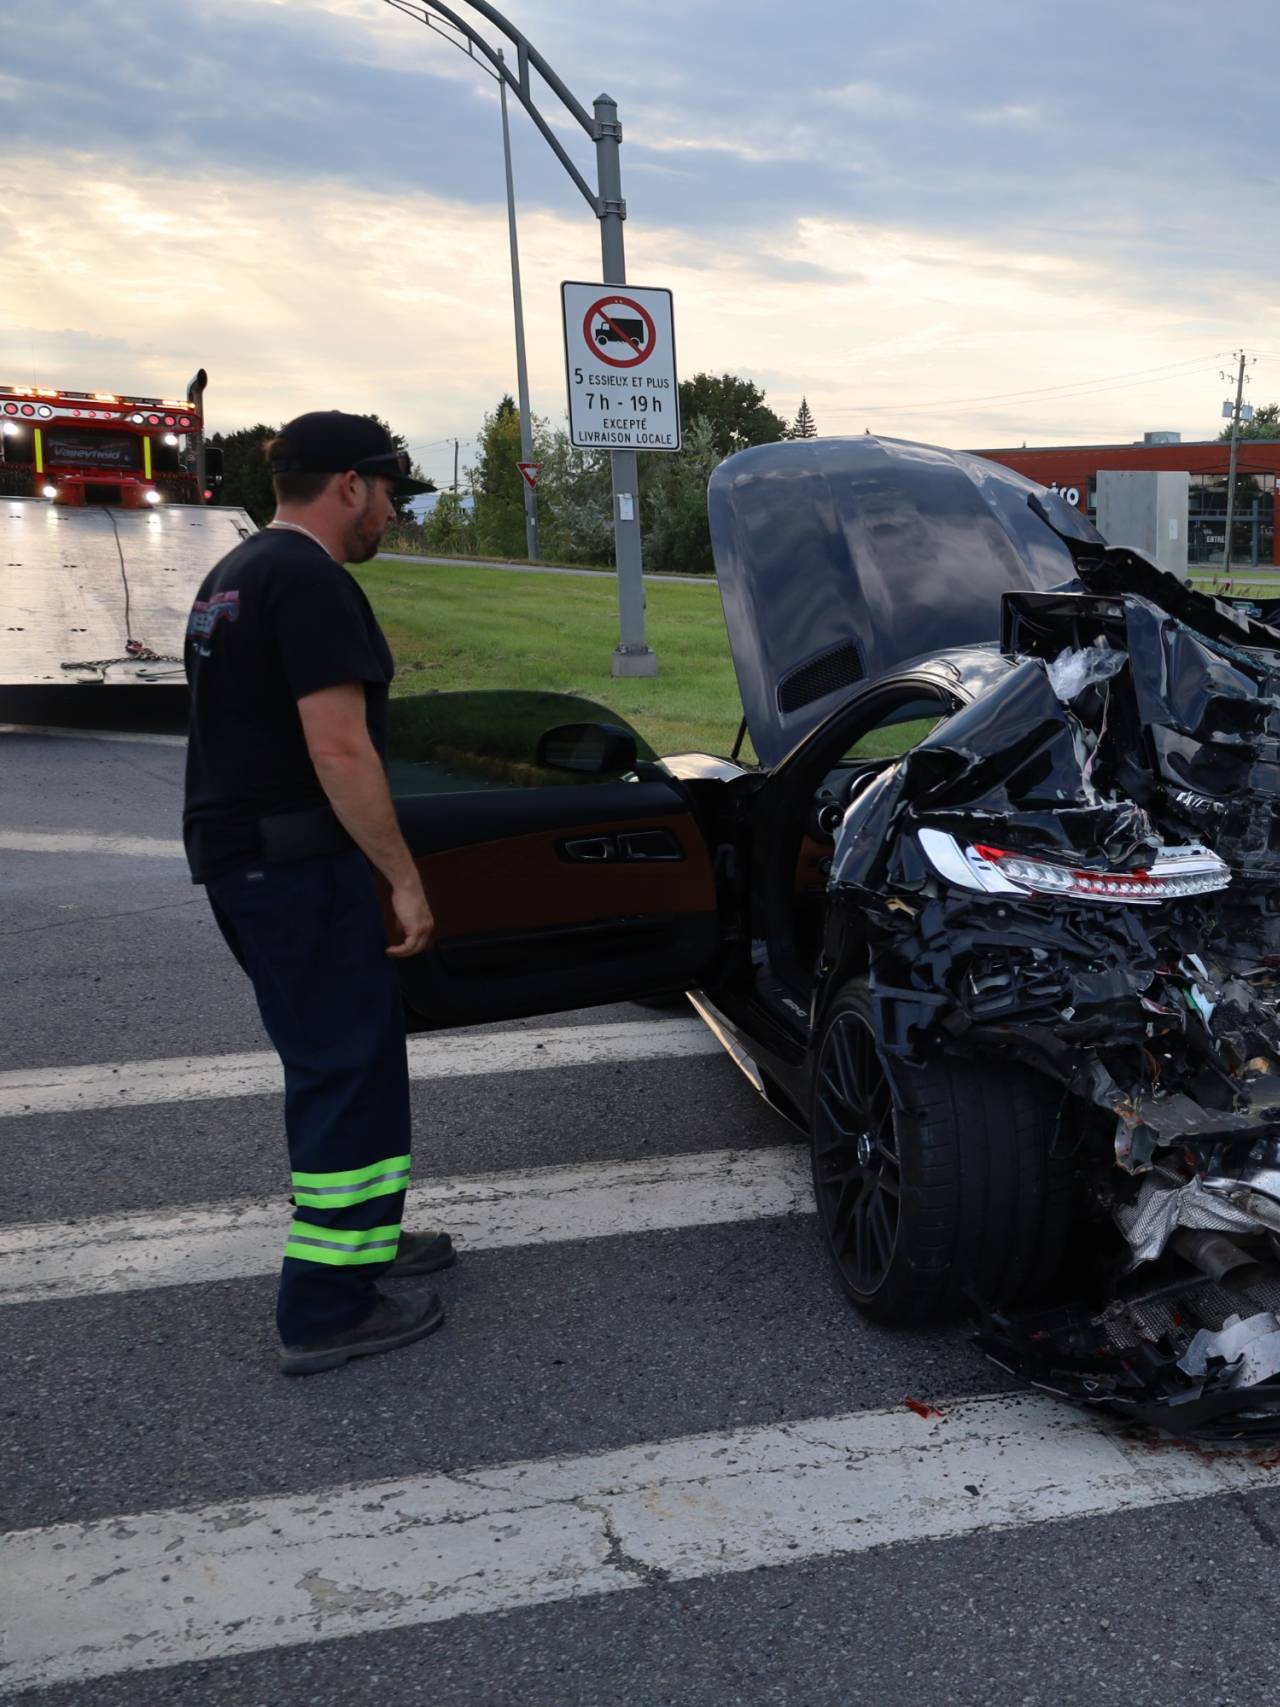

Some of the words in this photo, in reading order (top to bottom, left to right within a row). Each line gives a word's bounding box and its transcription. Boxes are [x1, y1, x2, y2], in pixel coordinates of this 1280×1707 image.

[575, 368, 584, 385] 5
[588, 374, 629, 387] ESSIEUX
[632, 377, 643, 388] ET
[647, 378, 670, 389] PLUS
[603, 417, 647, 431] EXCEPTÉ
[579, 431, 631, 443] LIVRAISON
[636, 433, 673, 445] LOCALE
